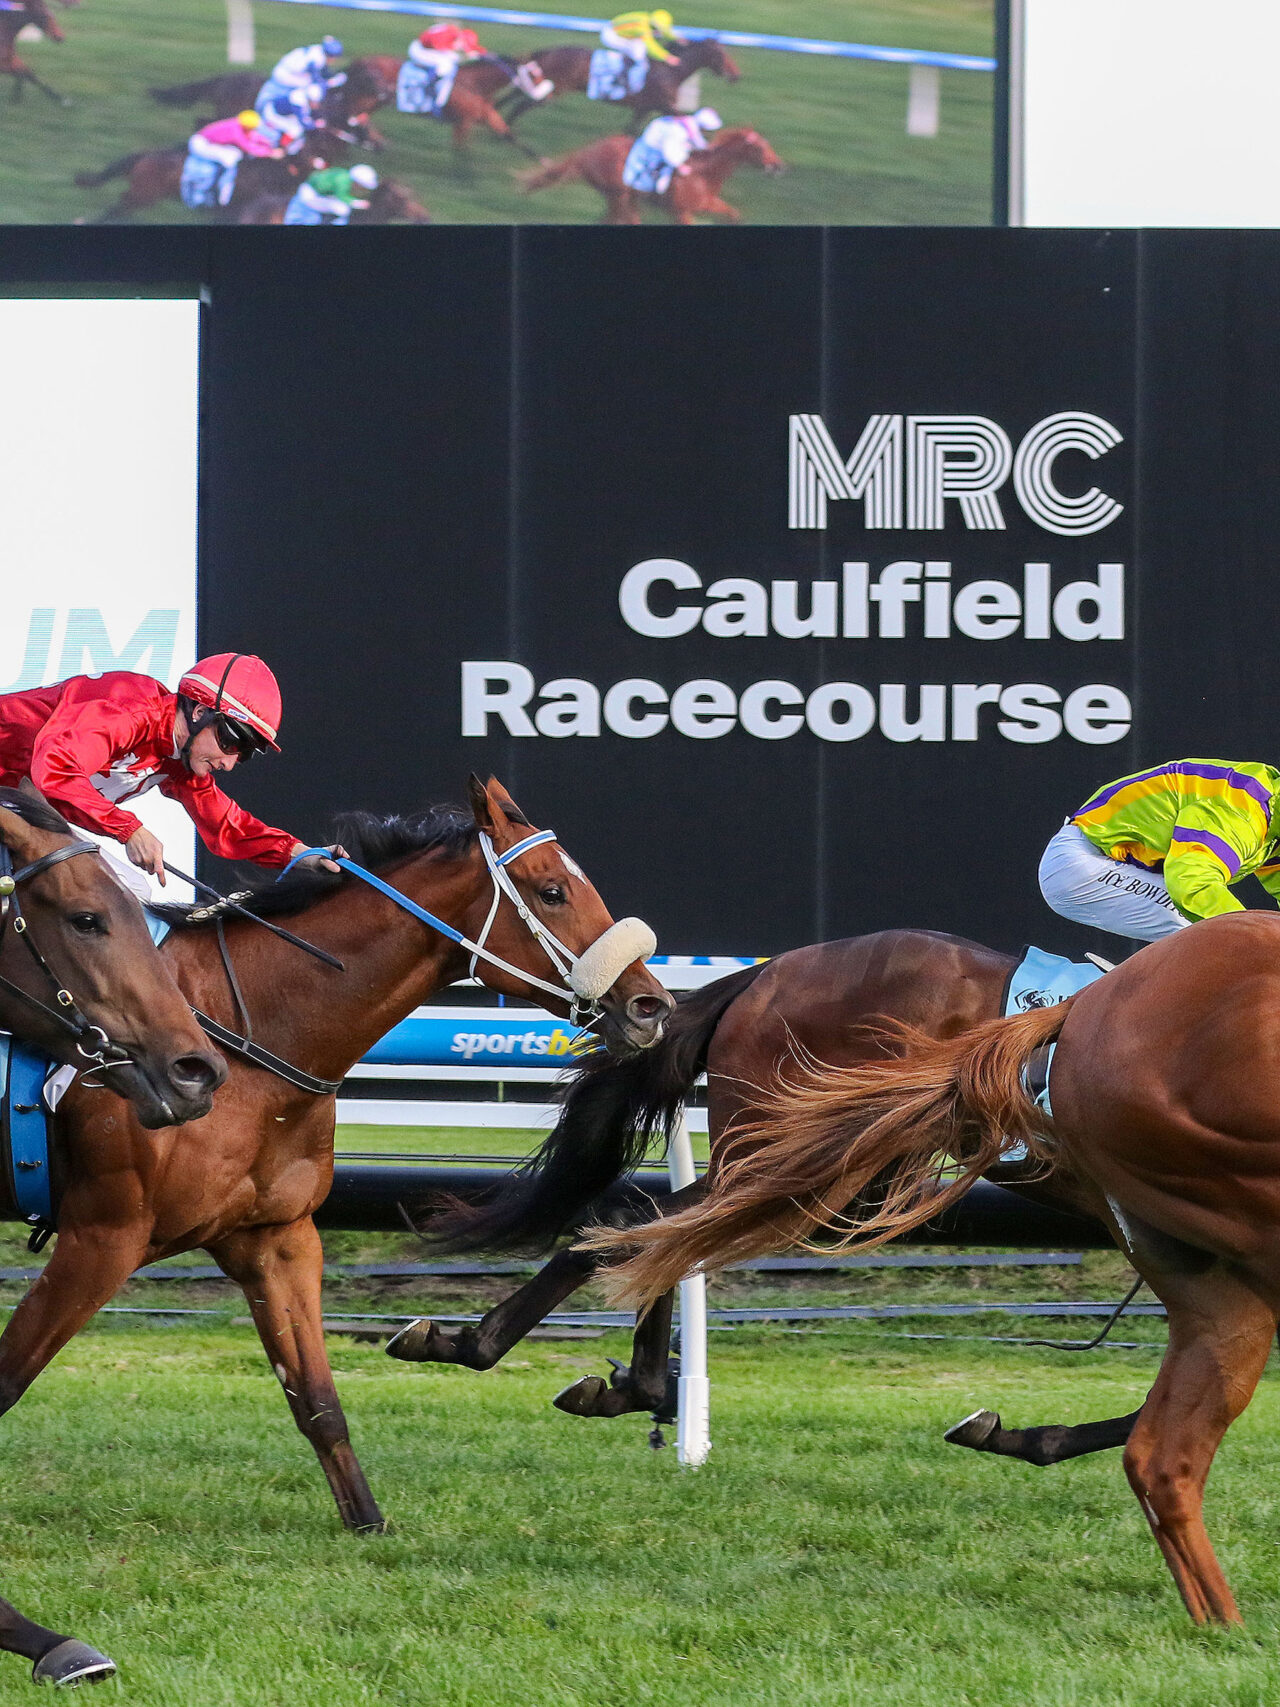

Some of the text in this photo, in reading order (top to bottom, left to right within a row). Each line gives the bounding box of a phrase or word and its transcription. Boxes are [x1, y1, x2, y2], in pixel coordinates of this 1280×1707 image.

[788, 411, 1124, 537] MRC
[618, 558, 1125, 642] Caulfield
[461, 660, 1132, 745] Racecourse
[1125, 878, 1184, 918] BOWDI
